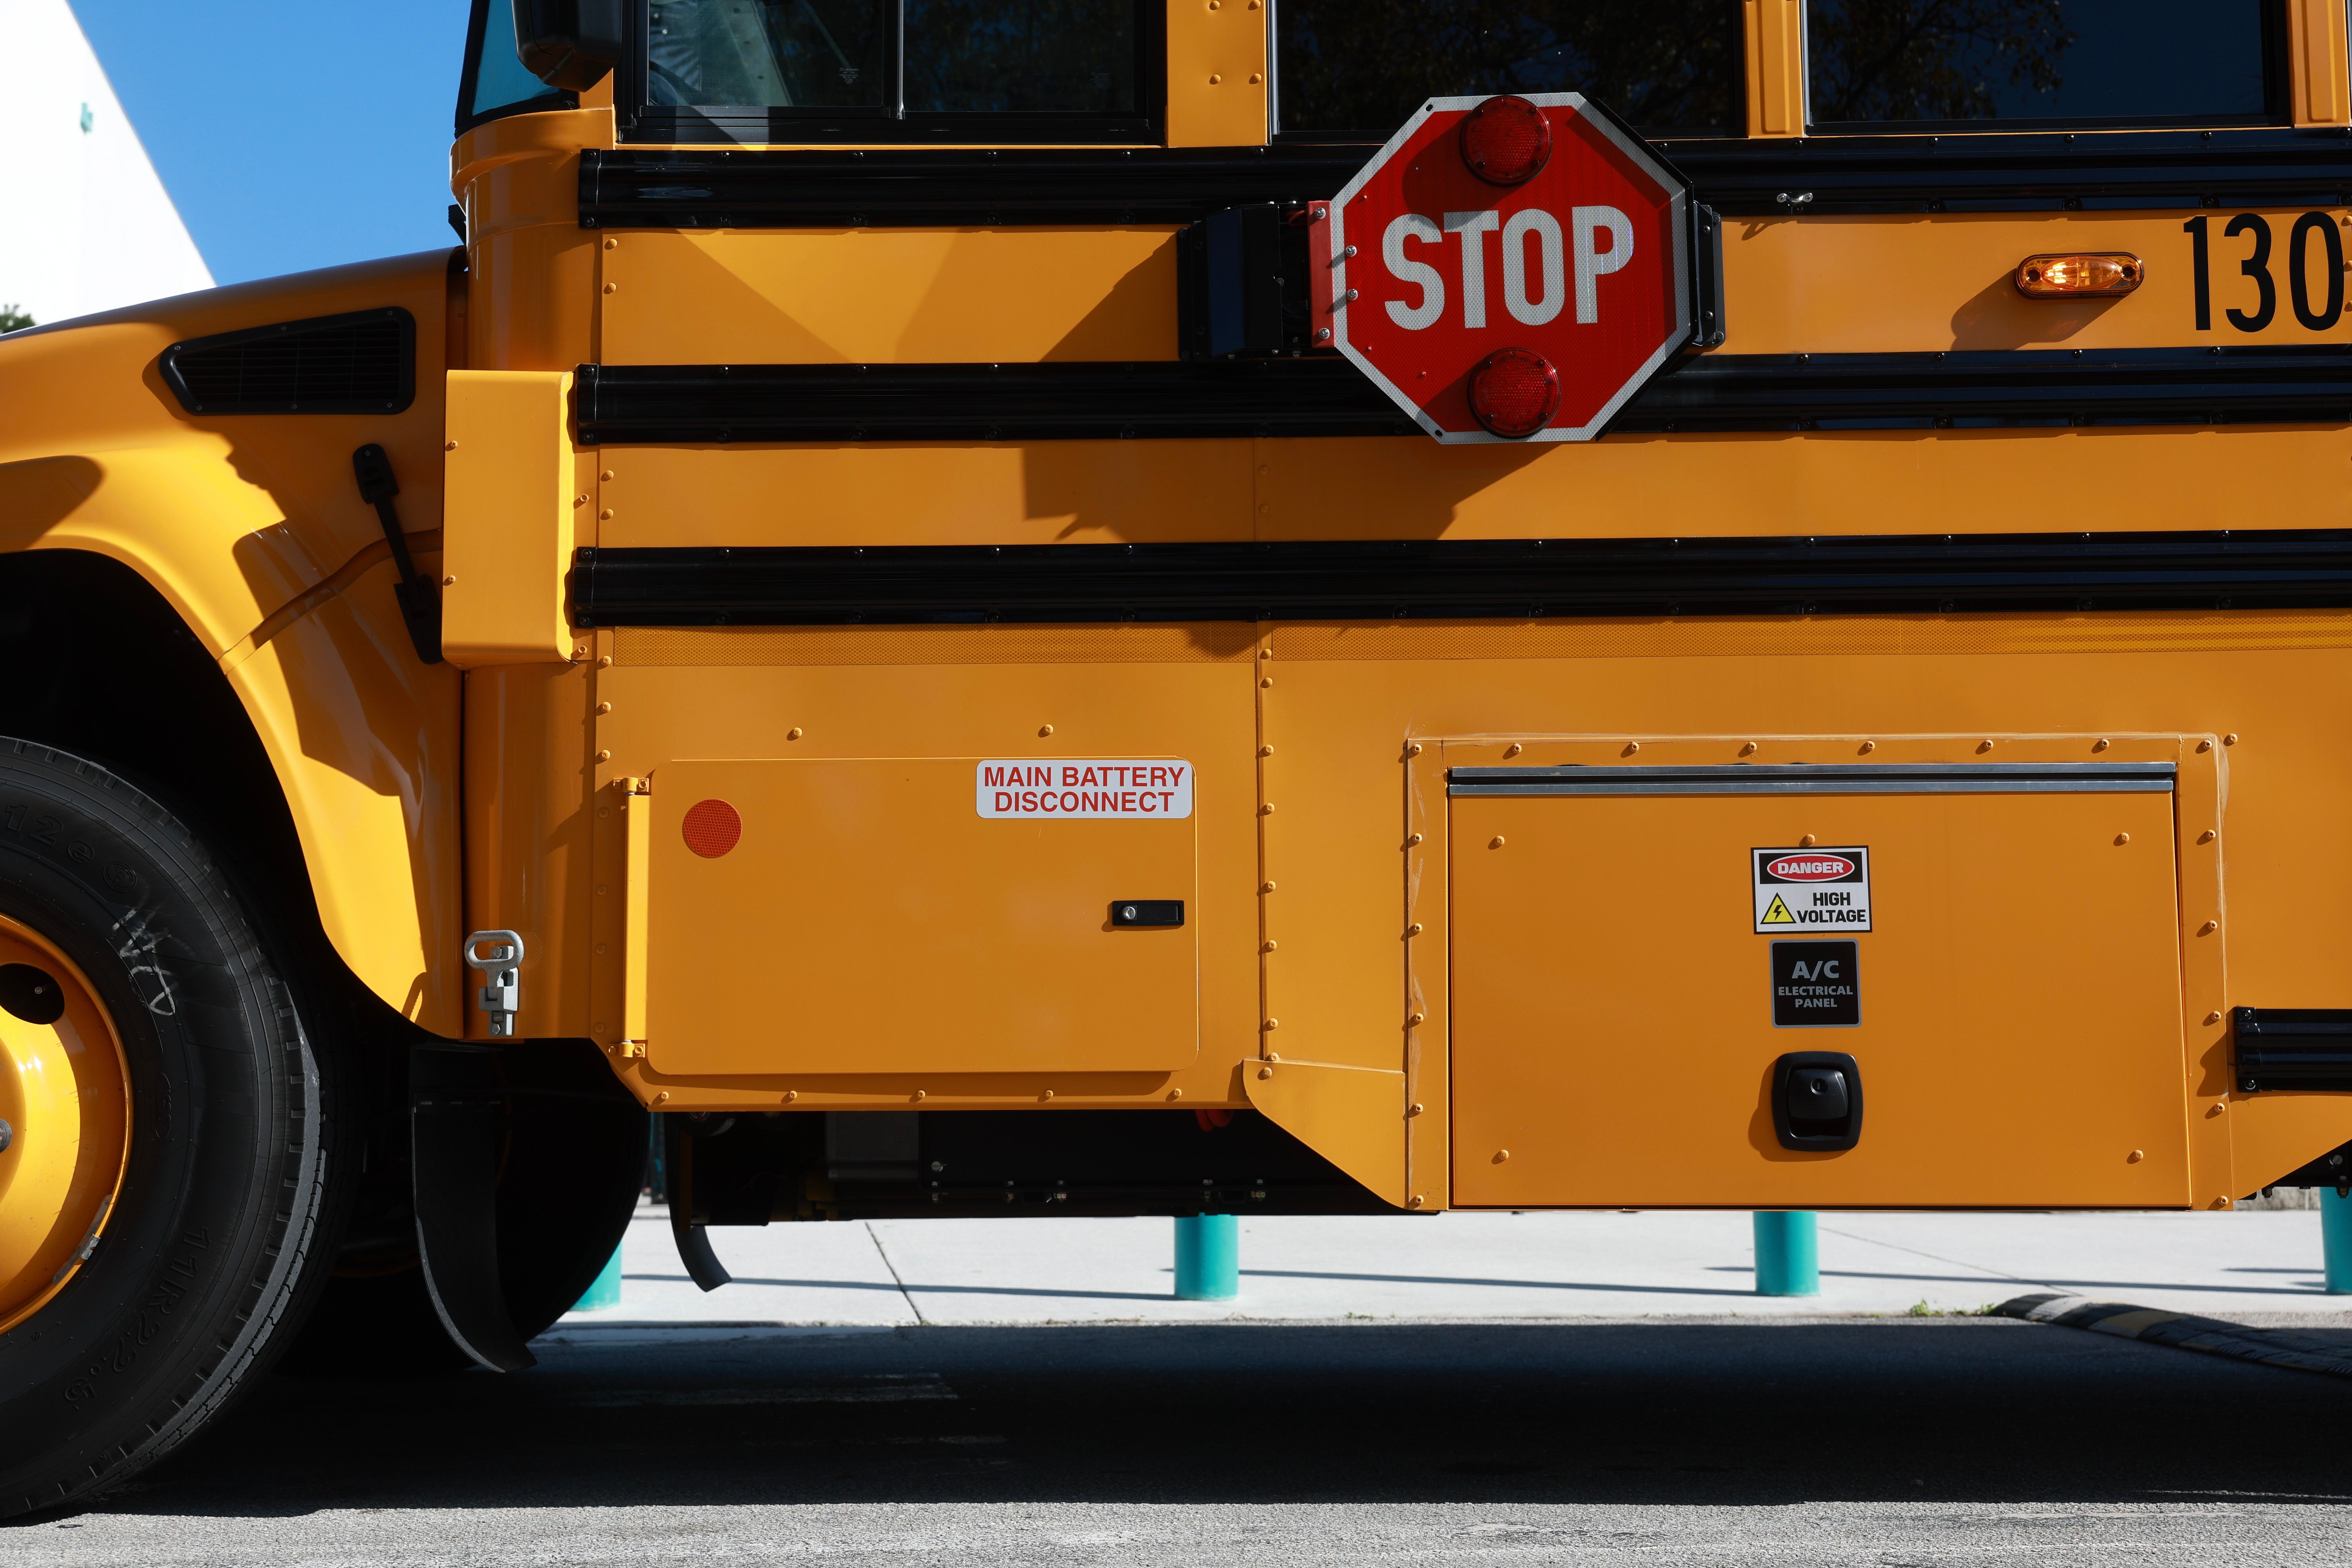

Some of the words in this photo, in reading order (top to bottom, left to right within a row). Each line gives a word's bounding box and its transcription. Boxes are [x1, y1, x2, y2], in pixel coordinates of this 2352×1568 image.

[1382, 205, 1634, 331] STOP
[985, 767, 1051, 786] MAIN
[1062, 767, 1185, 786] BATTERY
[995, 791, 1174, 812] DISCONNECT
[1777, 862, 1844, 874] DANGER
[1813, 892, 1851, 906] HIGH
[1796, 909, 1866, 924] VOLTAGE
[1791, 960, 1839, 981] A/C
[1778, 986, 1853, 996] ELECTRICAL
[1795, 998, 1837, 1008] PANEL
[63, 1227, 209, 1412] 11R22.5
